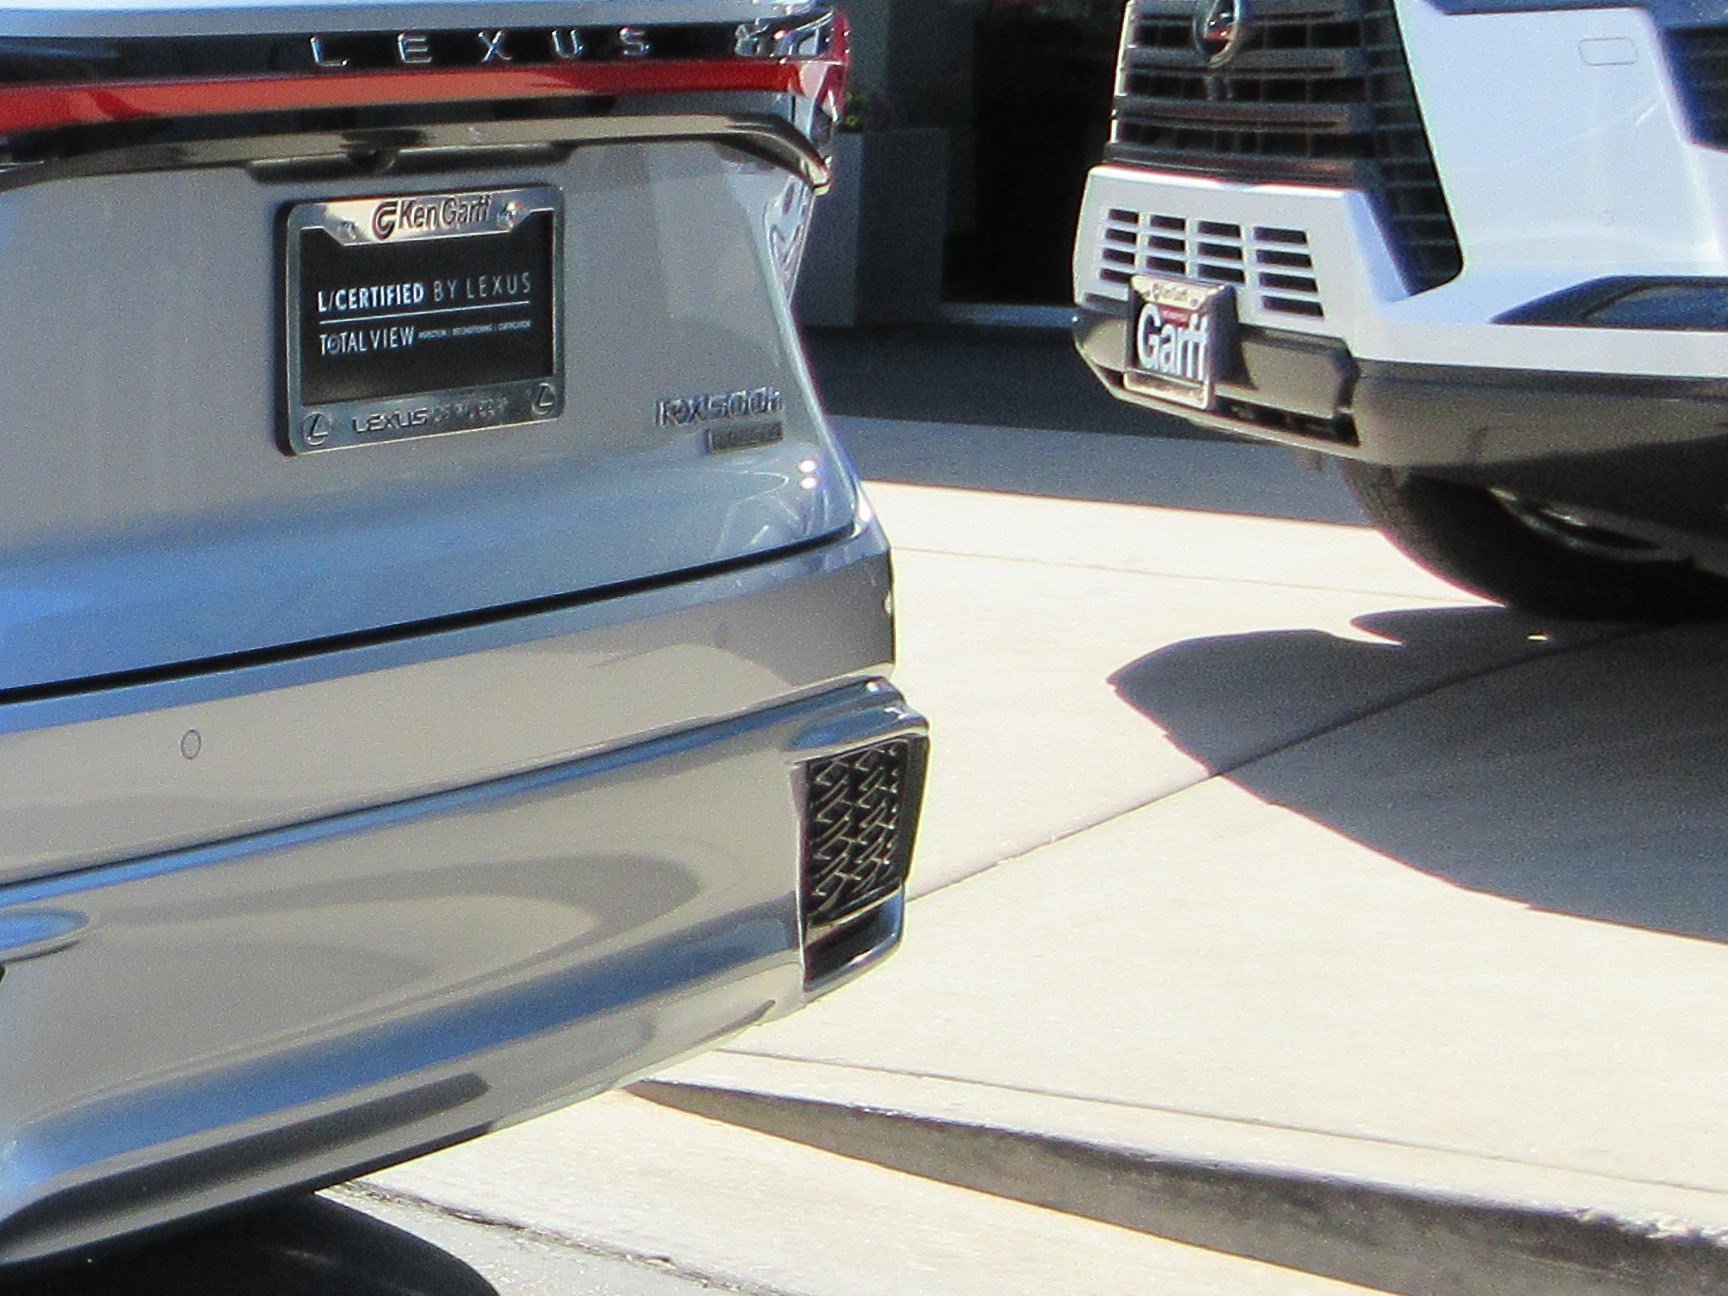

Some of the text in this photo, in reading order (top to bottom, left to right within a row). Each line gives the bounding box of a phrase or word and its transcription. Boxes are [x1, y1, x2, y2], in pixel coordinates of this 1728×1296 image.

[310, 26, 651, 68] LEXUS
[399, 200, 437, 230] Ken
[317, 271, 532, 313] L/CERTIFIED BY LEXUS
[1137, 302, 1208, 382] Garff
[352, 406, 431, 435] LEXUS
